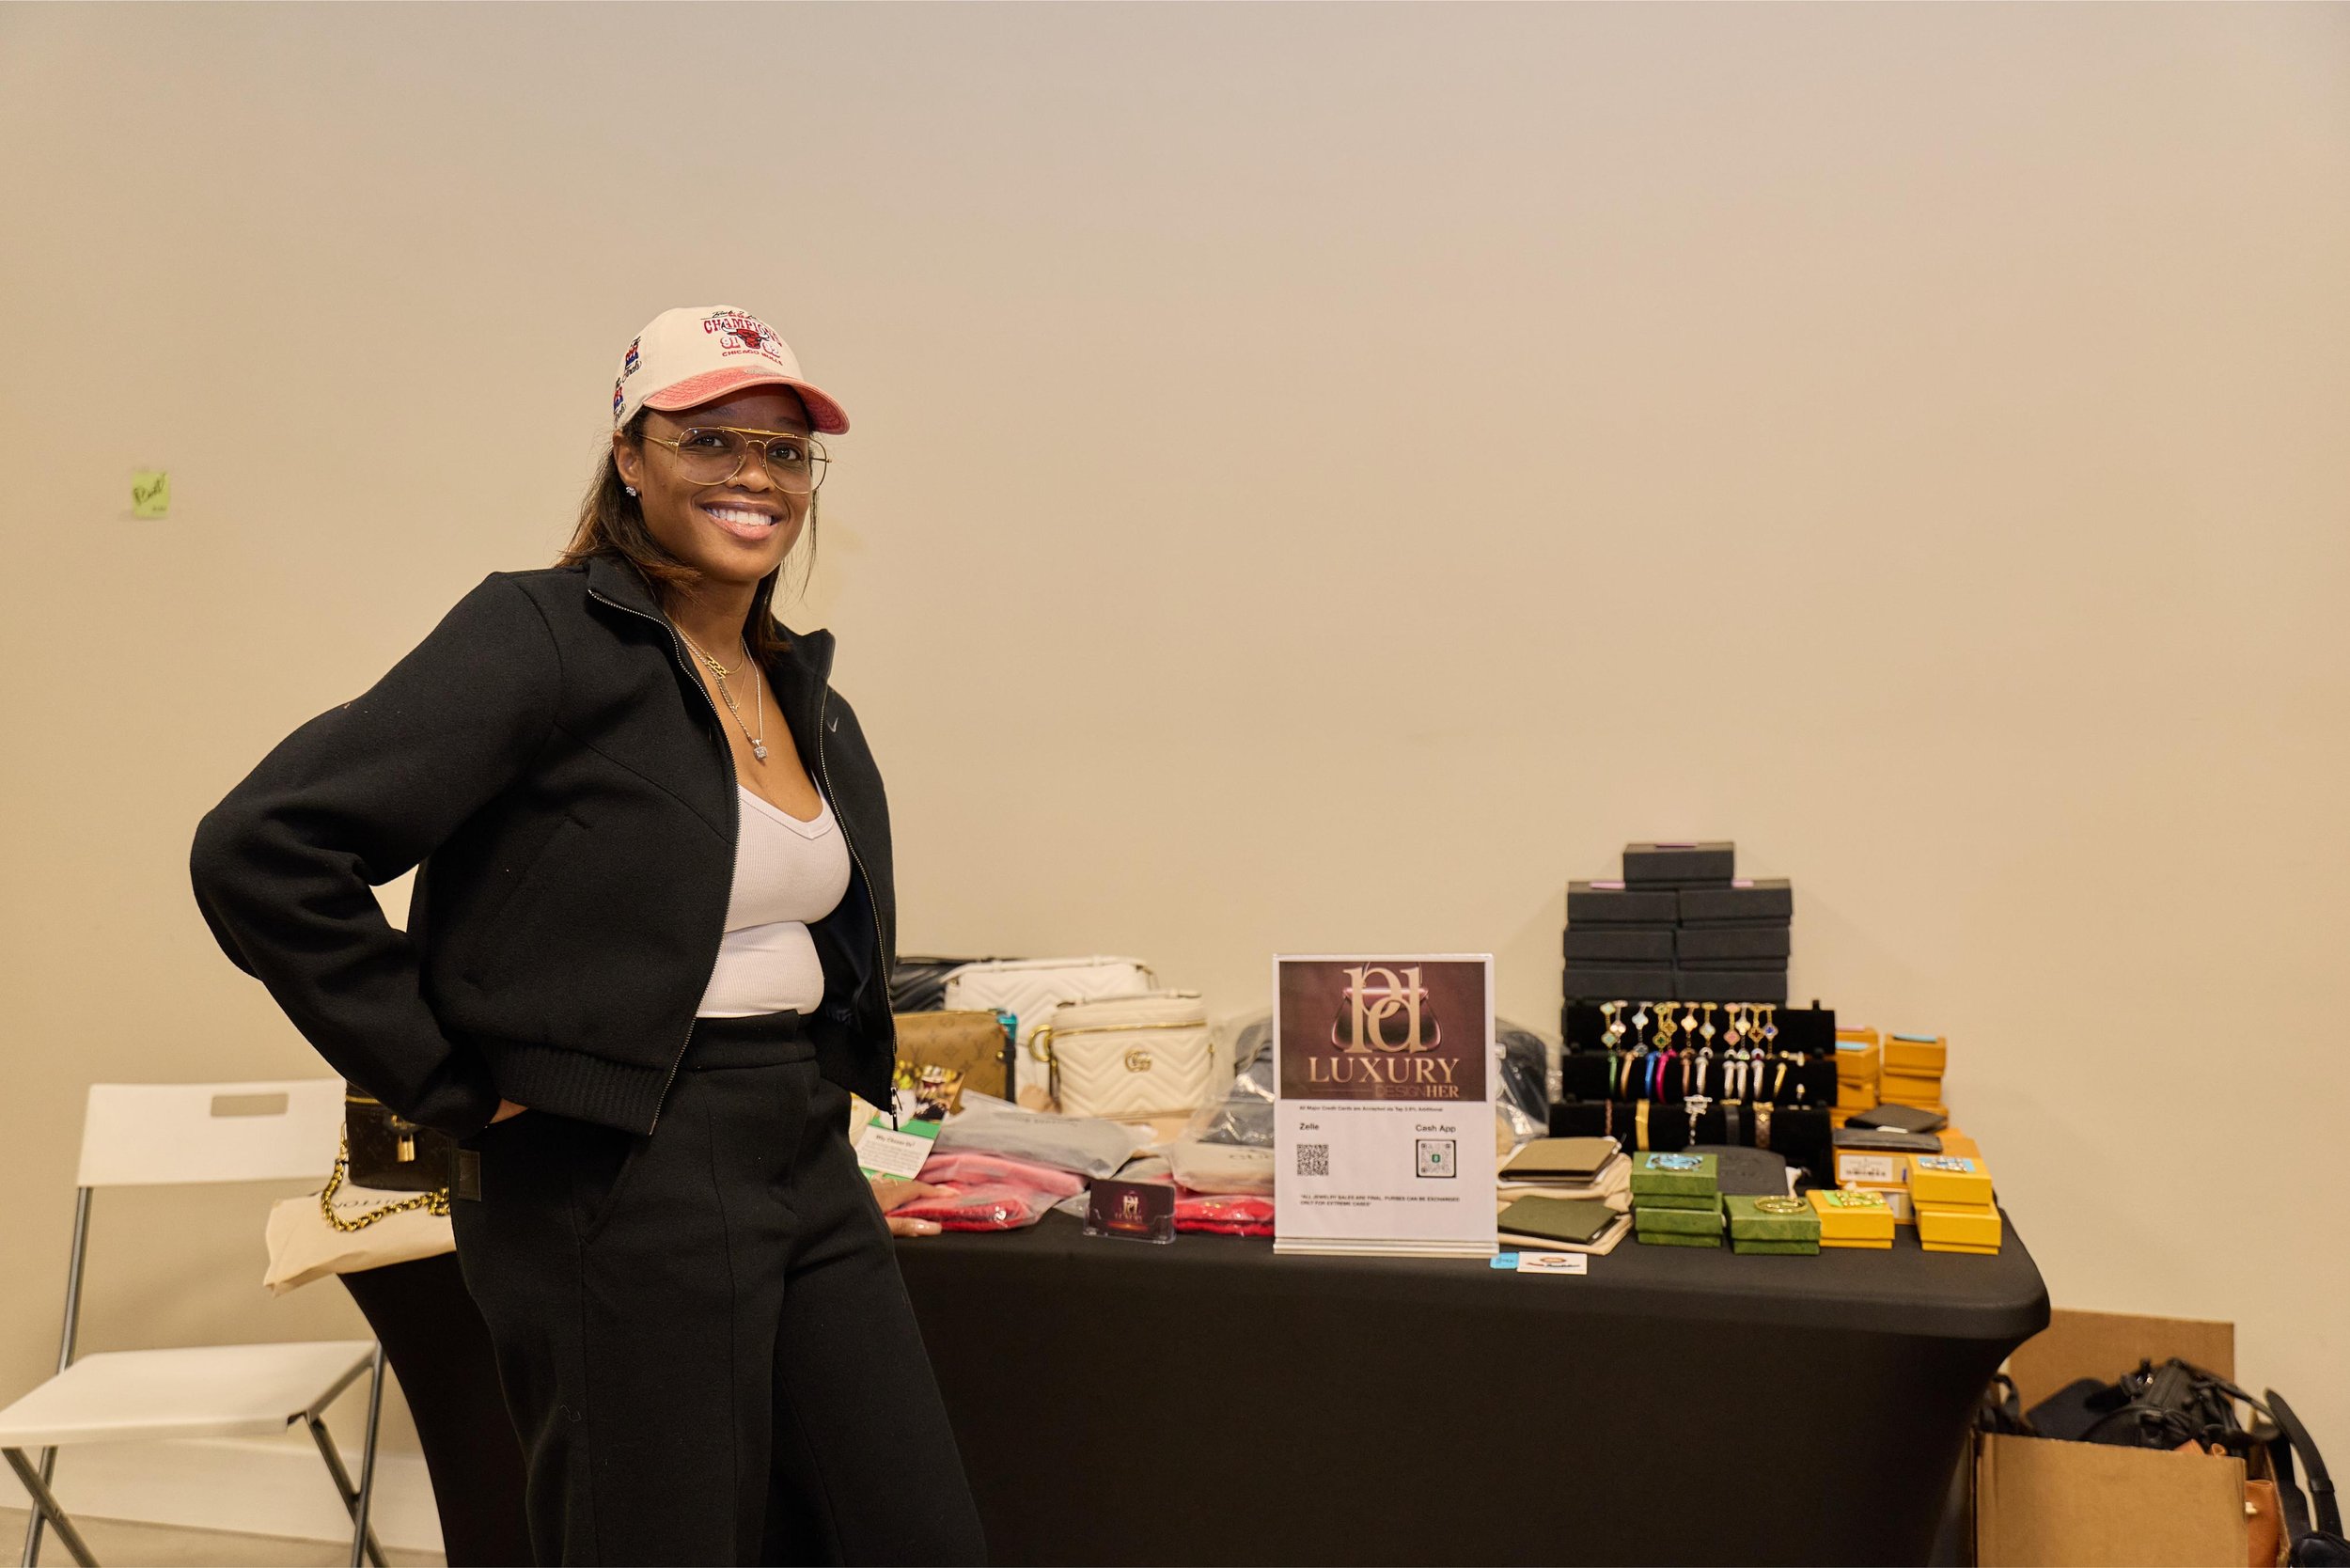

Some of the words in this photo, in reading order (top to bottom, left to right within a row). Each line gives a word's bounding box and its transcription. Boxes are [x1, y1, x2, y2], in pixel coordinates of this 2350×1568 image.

[722, 349, 760, 357] CHICAGO
[1308, 1057, 1459, 1083] LUXURY
[1299, 1122, 1320, 1131] Zelle
